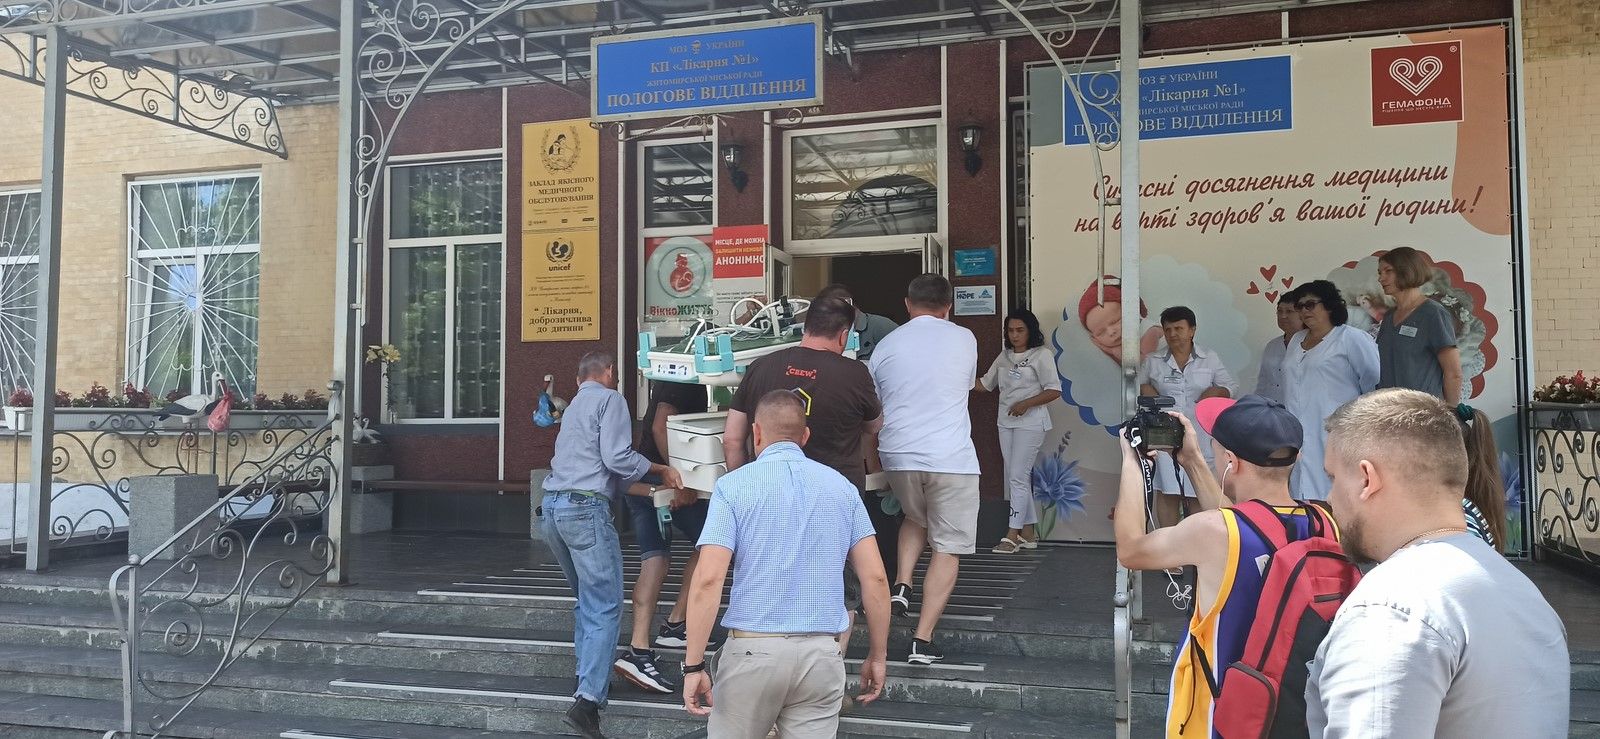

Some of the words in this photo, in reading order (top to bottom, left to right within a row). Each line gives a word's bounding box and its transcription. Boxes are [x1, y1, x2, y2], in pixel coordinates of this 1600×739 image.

[669, 45, 687, 54] МОЗ
[706, 39, 745, 50] УКРАЇНИ
[651, 61, 669, 73] КП
[672, 57, 729, 71] «Лікарня
[732, 53, 760, 66] №1»
[646, 75, 707, 87] ЖИТОМИРСЬКОЇ
[708, 72, 741, 82] МІСЬКОЇ
[742, 70, 763, 79] РАДИ
[1170, 70, 1218, 83] УКРАЇНИ
[607, 87, 696, 108] ПОЛОГОВЕ
[701, 78, 807, 101] ВІДДІЛЕННЯ
[1142, 87, 1209, 103] «Лікарня
[1213, 83, 1246, 97] №1»
[1181, 101, 1218, 112] МІСЬКОЇ
[1221, 100, 1244, 109] РАДИ
[1382, 97, 1452, 110] ГЕМАФОНД
[1171, 108, 1283, 130] ВІДДІЛЕННЯ
[529, 179, 556, 188] ЗАКЛАД
[558, 176, 595, 185] ЯКІСНОГО
[1185, 171, 1315, 203] досягнення
[1323, 164, 1448, 193] медицини
[538, 186, 584, 195] МЕДИЧНОГО
[528, 194, 594, 205] ОБСЛУГОВУВАННЯ
[1074, 217, 1101, 233] на
[1186, 197, 1286, 234] здоров'я
[1296, 195, 1371, 222] вашої
[1374, 185, 1484, 226] родини!
[715, 238, 735, 246] МІСЦЕ,
[735, 238, 743, 246] ДЕ
[743, 237, 765, 245] МОЖНА
[715, 254, 765, 266] АНОНІМНО
[548, 263, 571, 272] unicef
[529, 316, 592, 326] доброзичлива
[536, 326, 548, 334] до
[551, 325, 584, 333] дитини
[789, 368, 814, 377] CREW
[1143, 458, 1152, 493] LUMIX
